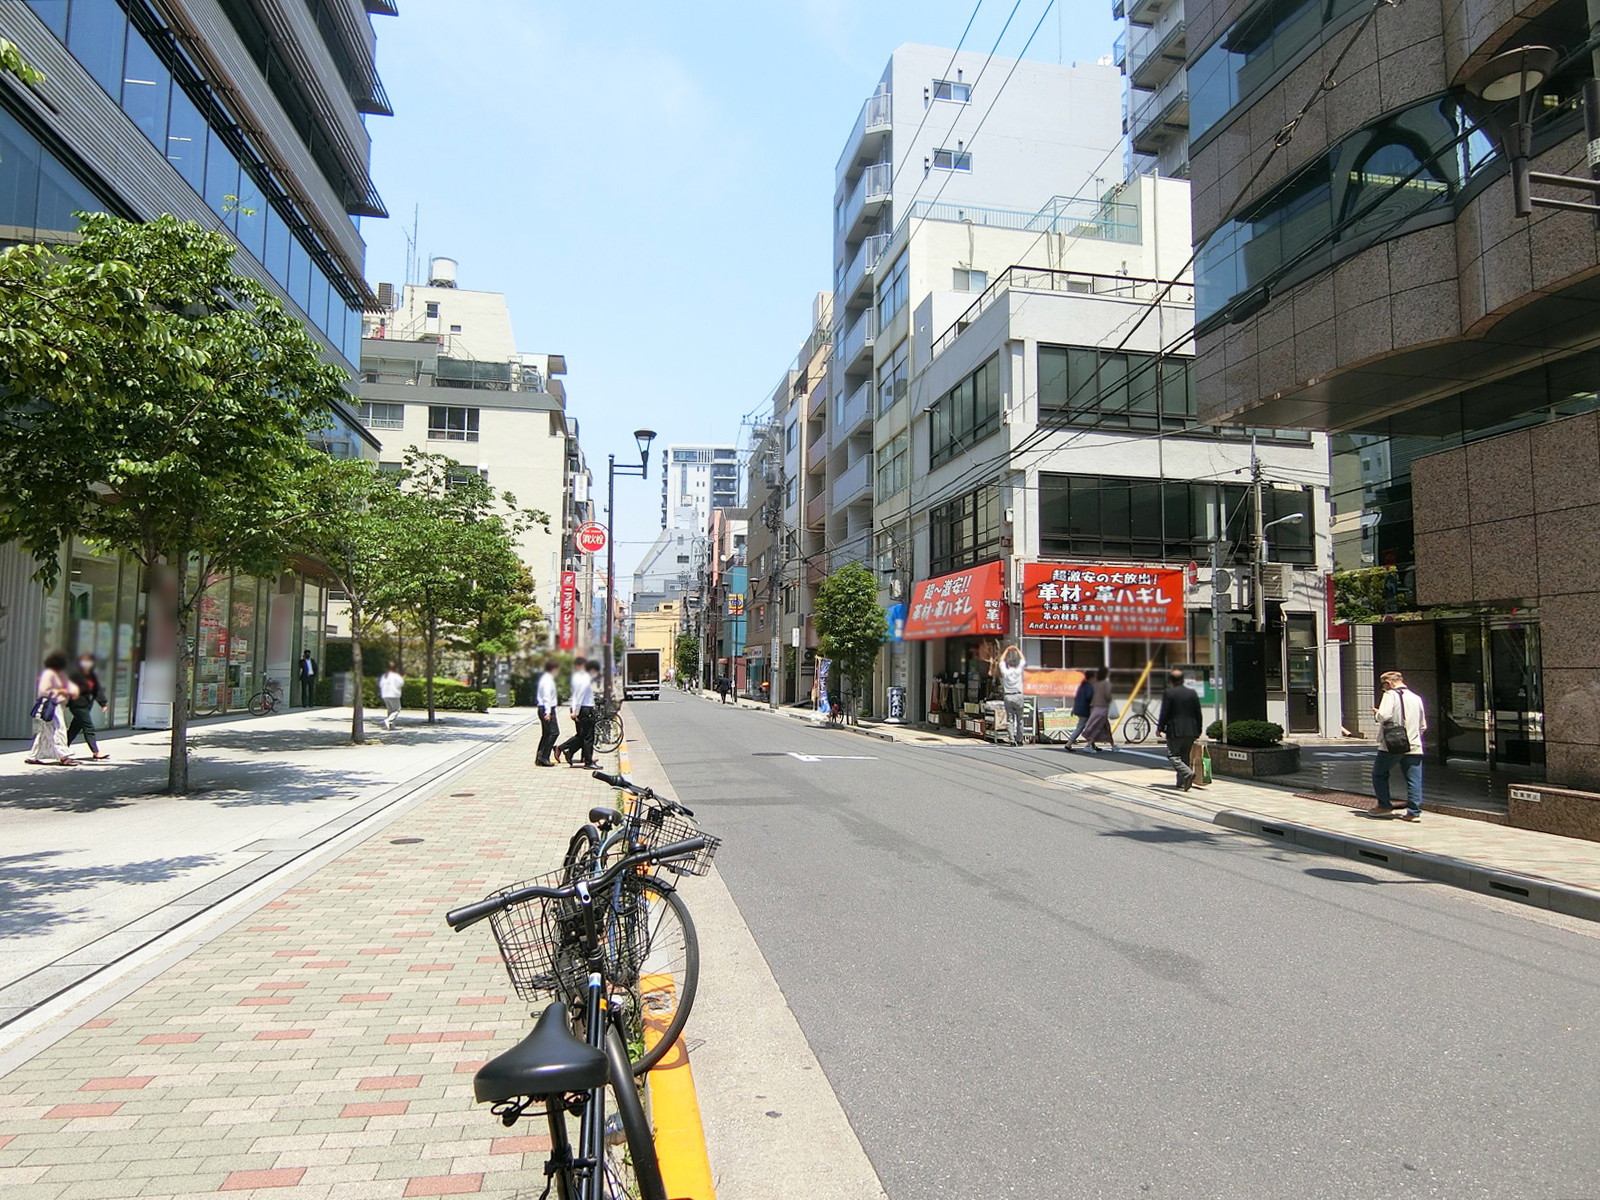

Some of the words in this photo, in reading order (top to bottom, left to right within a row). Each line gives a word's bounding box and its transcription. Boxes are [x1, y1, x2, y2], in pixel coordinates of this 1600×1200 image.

[583, 534, 603, 545] 消火栓
[1052, 569, 1158, 586] 超激安の大放出!
[1037, 582, 1172, 605] 革材・革ハギレ
[912, 596, 973, 620] 革材・革ハギレ
[985, 608, 1000, 621] 革
[1028, 622, 1043, 630] And
[1044, 622, 1076, 631] Leather
